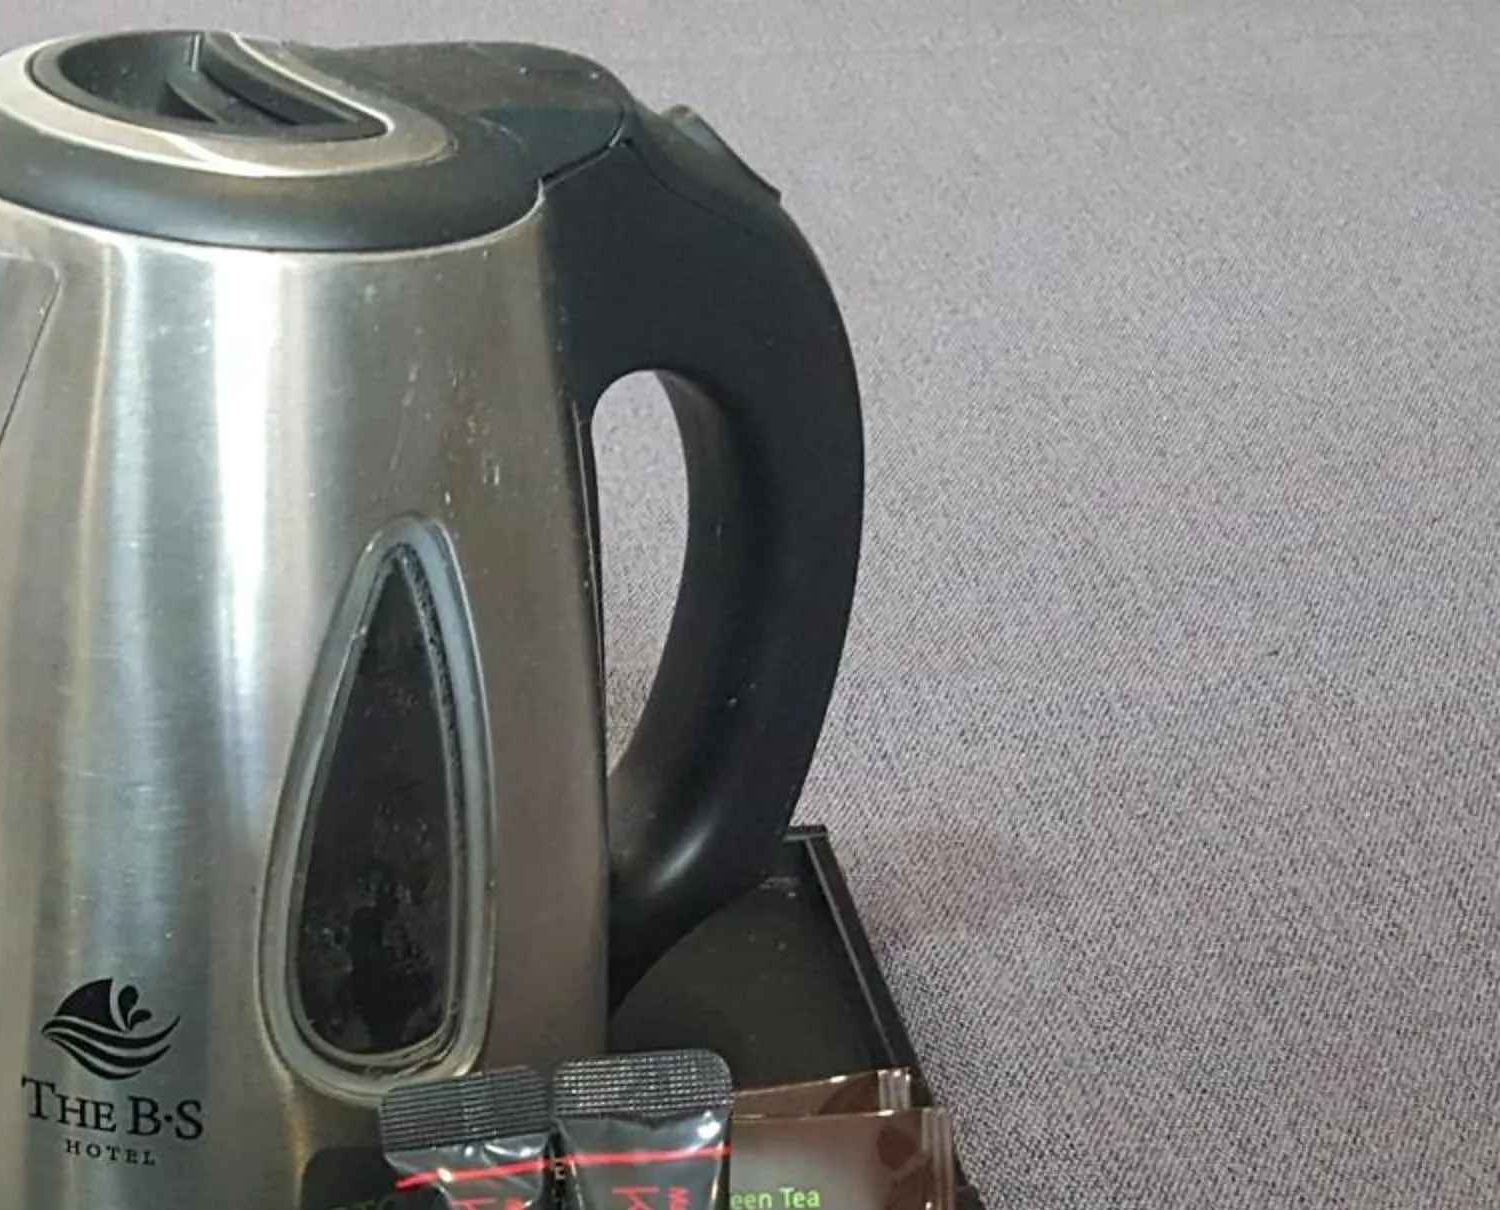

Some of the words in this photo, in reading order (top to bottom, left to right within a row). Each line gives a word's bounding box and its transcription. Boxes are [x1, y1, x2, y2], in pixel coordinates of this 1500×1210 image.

[21, 1074, 117, 1133] THE
[65, 1138, 156, 1166] HOTEL
[779, 1186, 821, 1209] Tea
